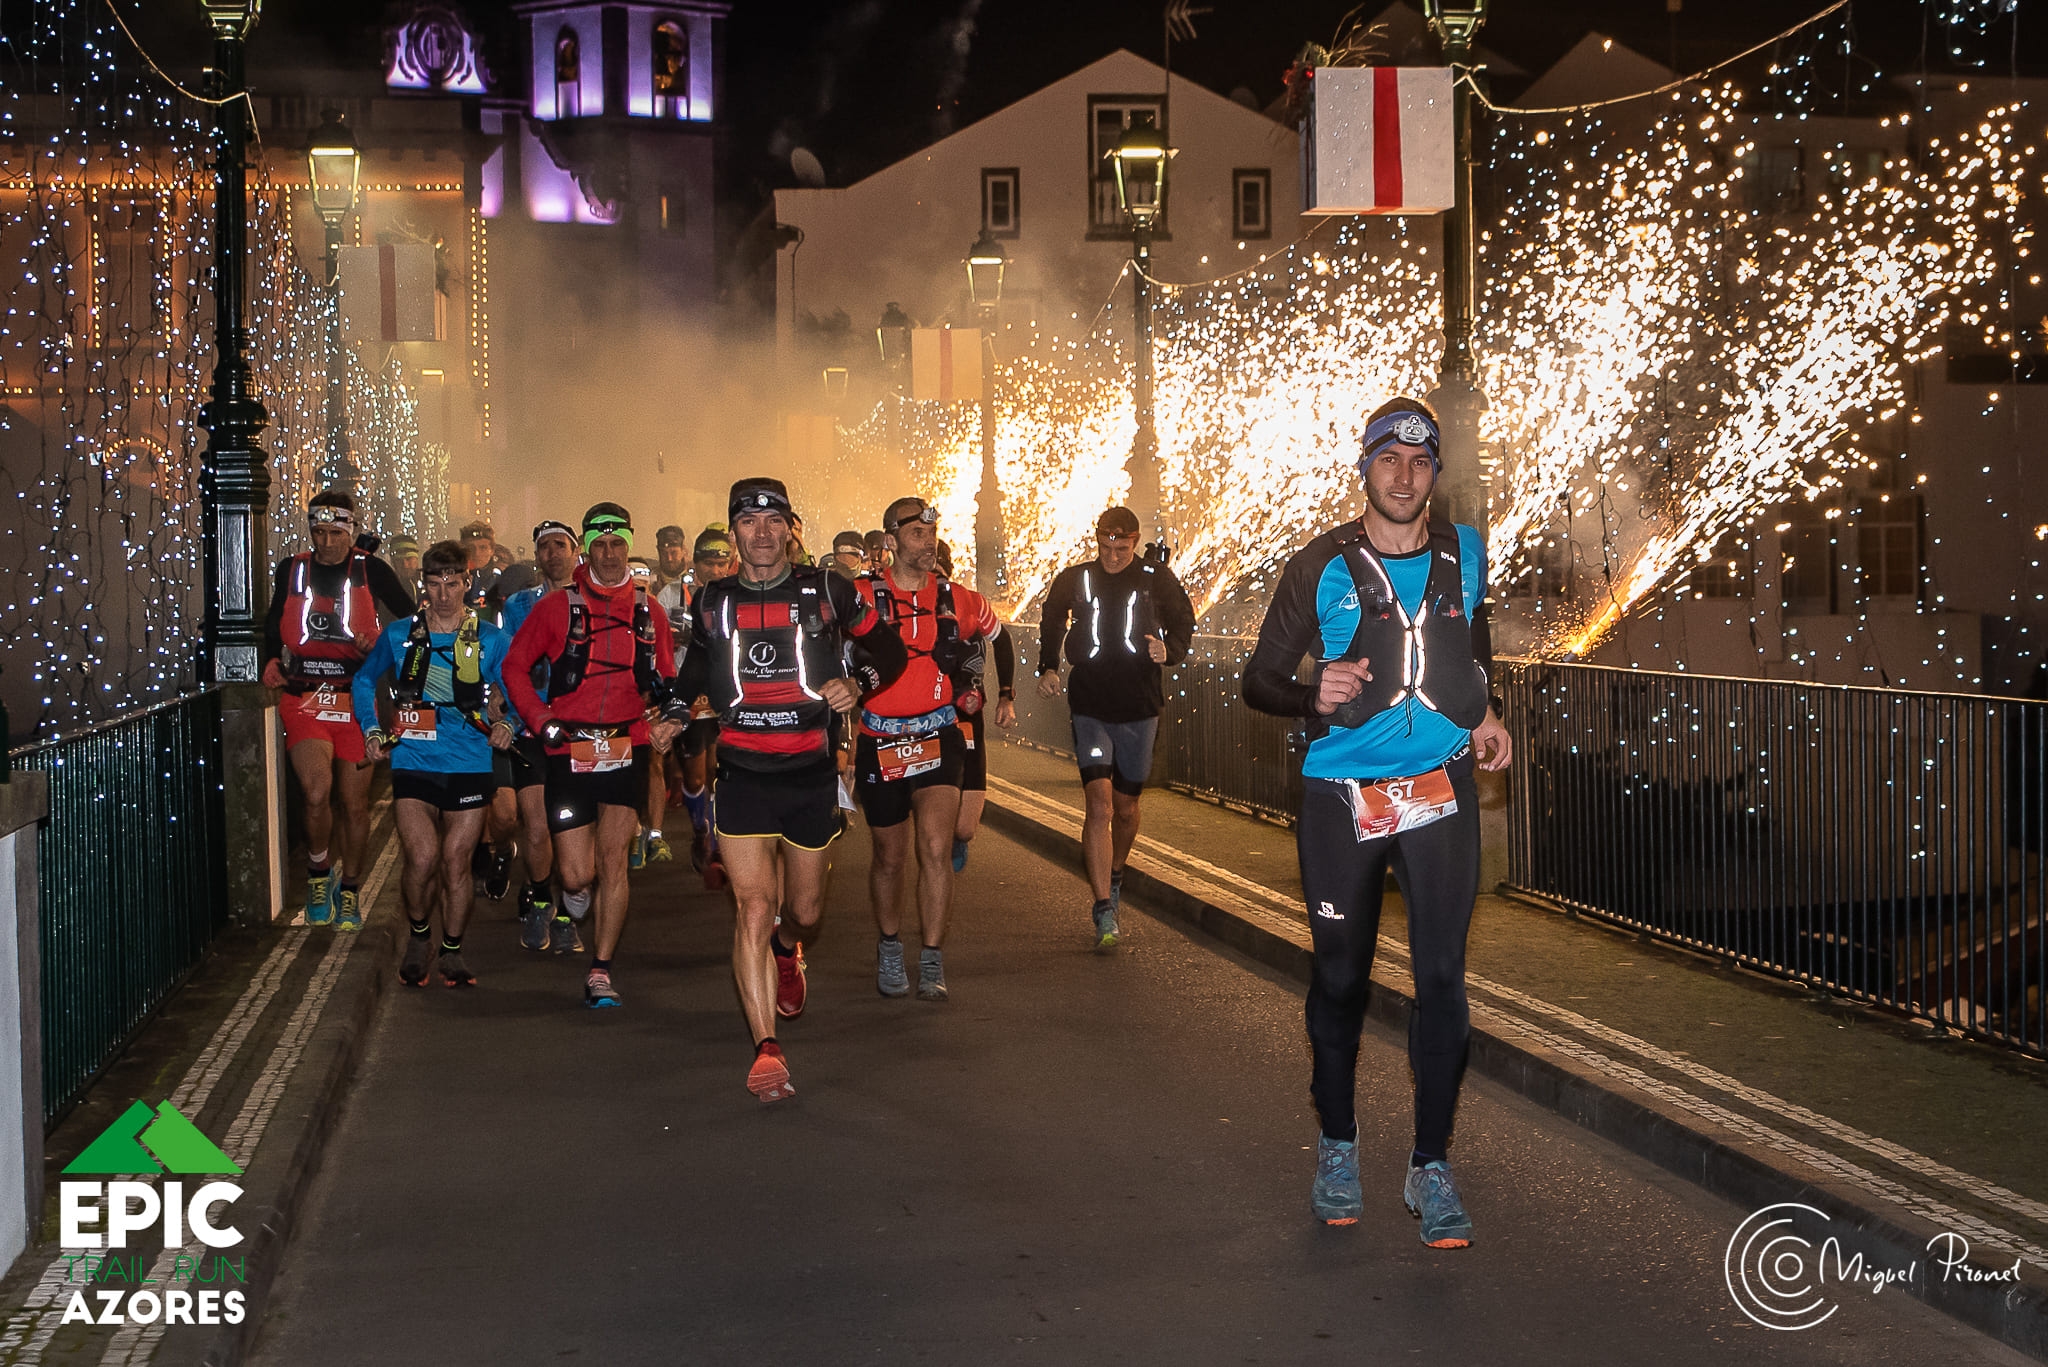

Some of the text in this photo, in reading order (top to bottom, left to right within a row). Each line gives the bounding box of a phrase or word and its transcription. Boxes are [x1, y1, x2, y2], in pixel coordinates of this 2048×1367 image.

[317, 692, 338, 705] 121
[398, 710, 420, 724] 110
[593, 739, 611, 754] 14
[895, 743, 924, 759] 104
[1386, 779, 1415, 803] 67
